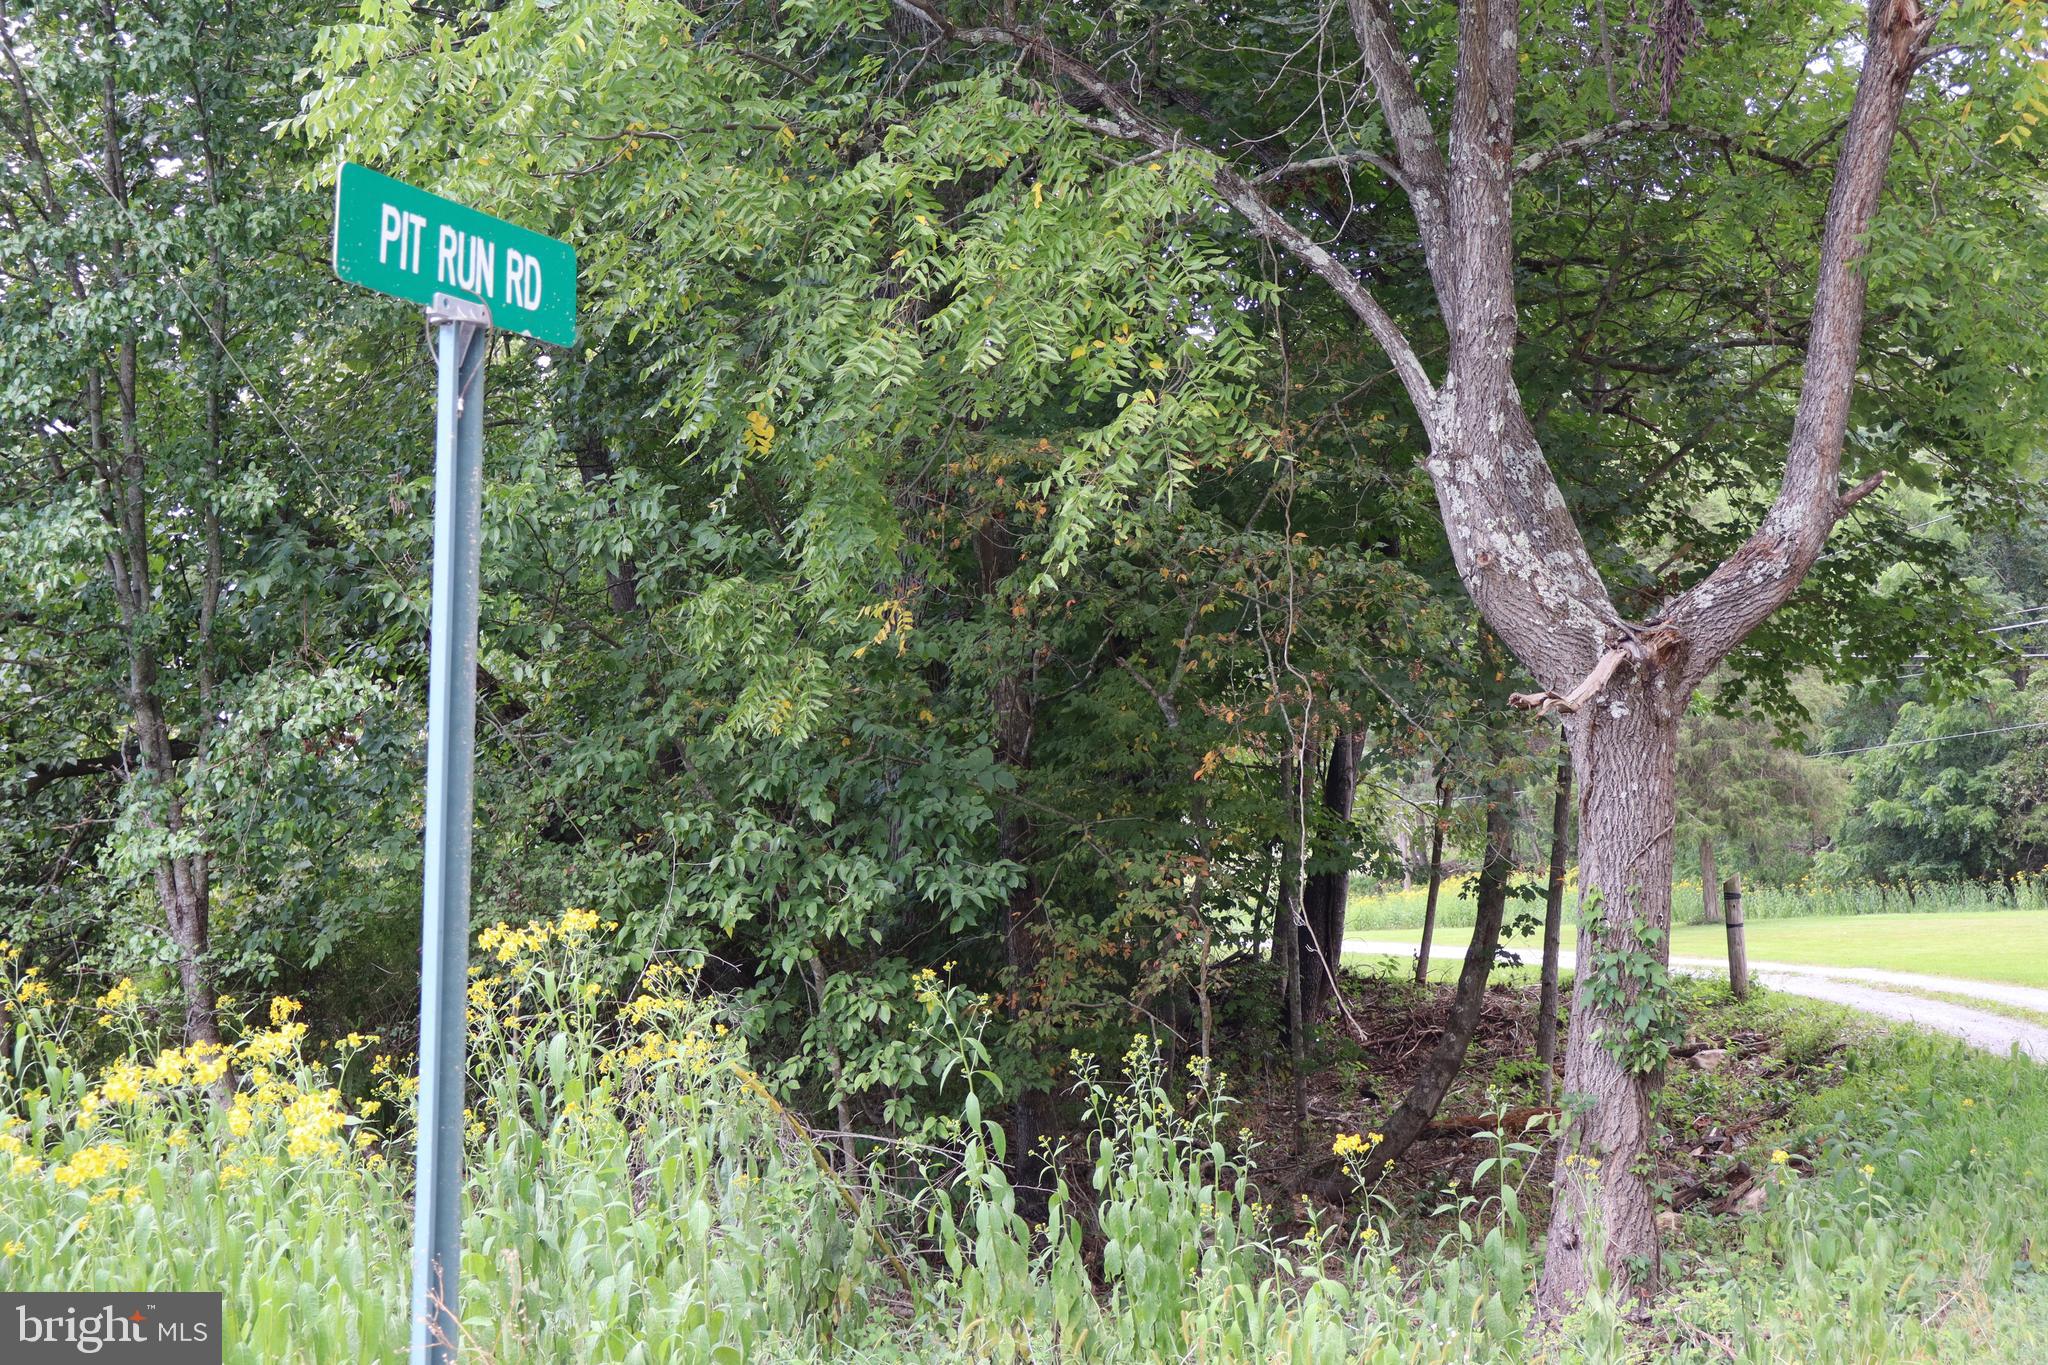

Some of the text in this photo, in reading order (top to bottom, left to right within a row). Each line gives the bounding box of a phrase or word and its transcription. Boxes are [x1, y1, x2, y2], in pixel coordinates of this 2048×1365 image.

[379, 203, 542, 311] PIT RUN RD
